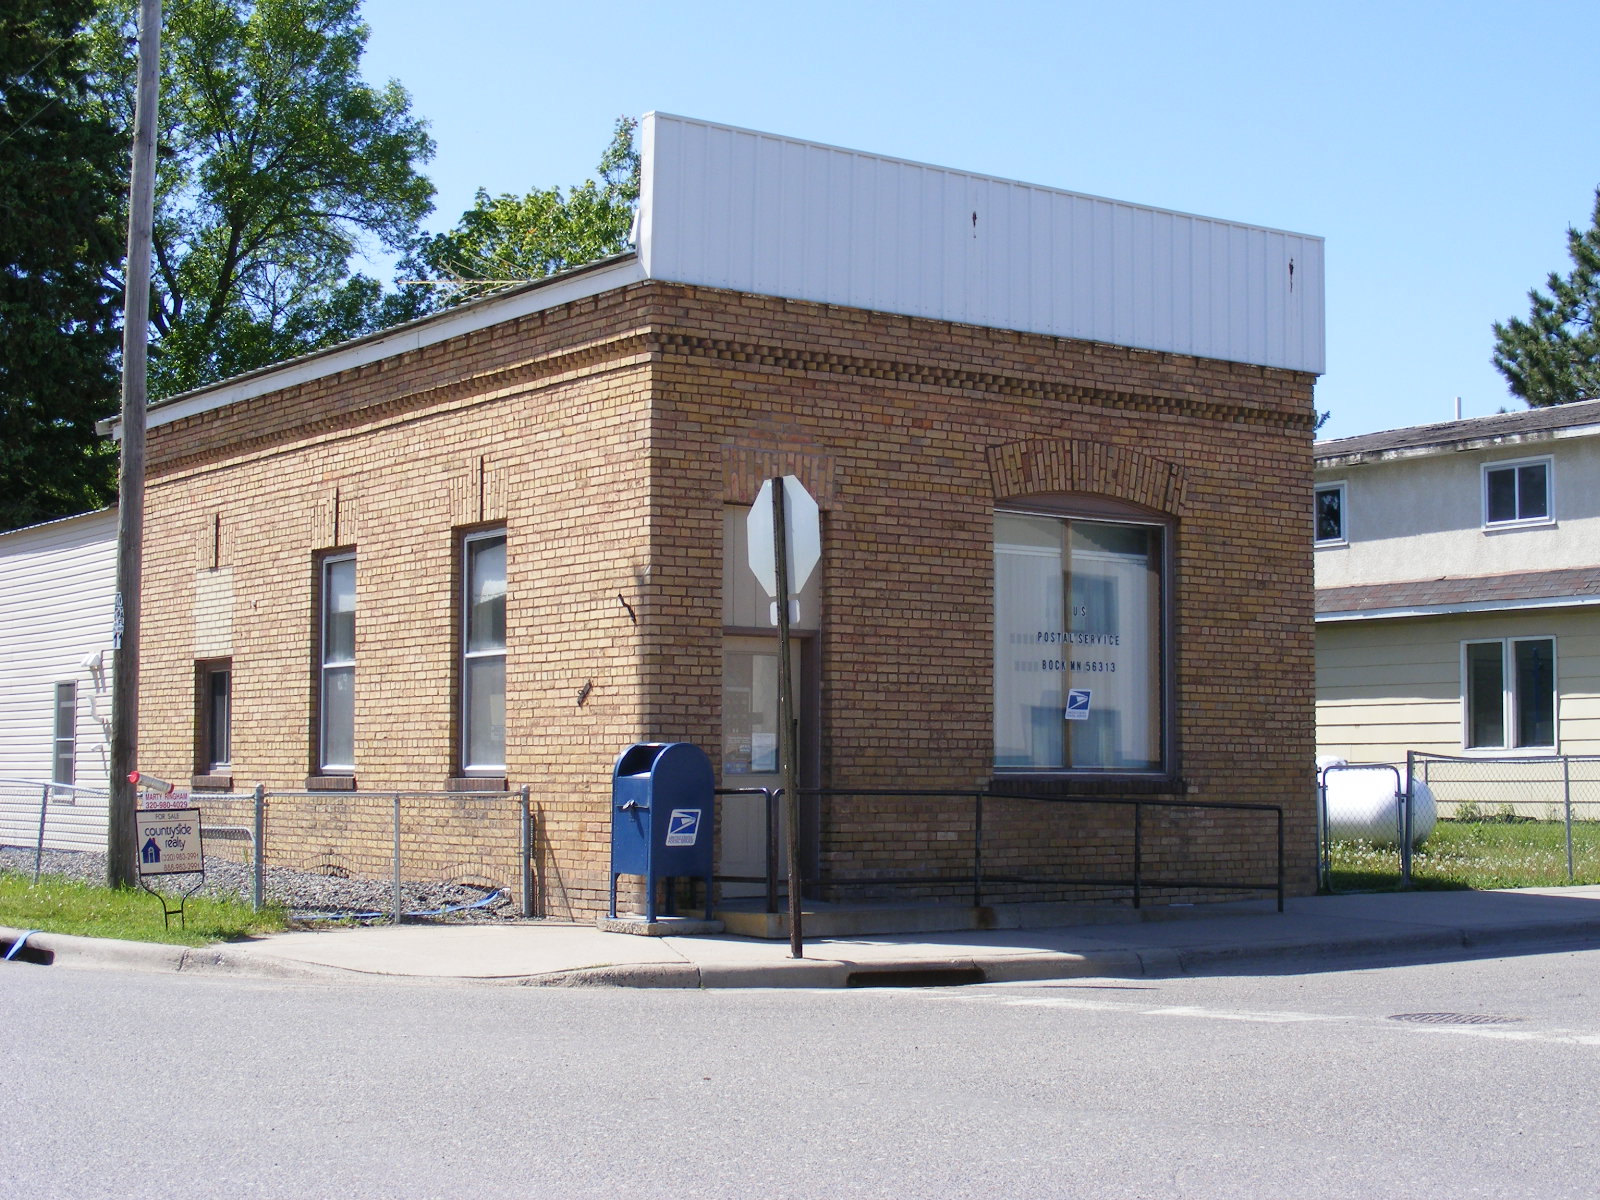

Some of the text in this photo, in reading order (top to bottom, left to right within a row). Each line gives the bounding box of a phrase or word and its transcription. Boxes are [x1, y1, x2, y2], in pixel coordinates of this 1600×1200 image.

[1073, 606, 1086, 616] US
[1037, 631, 1120, 646] POSTAL SERVICE
[1042, 660, 1116, 673] BOCK MN 56313
[145, 801, 188, 809] 320-980-4029
[144, 823, 192, 838] countryside
[165, 837, 186, 851] realty
